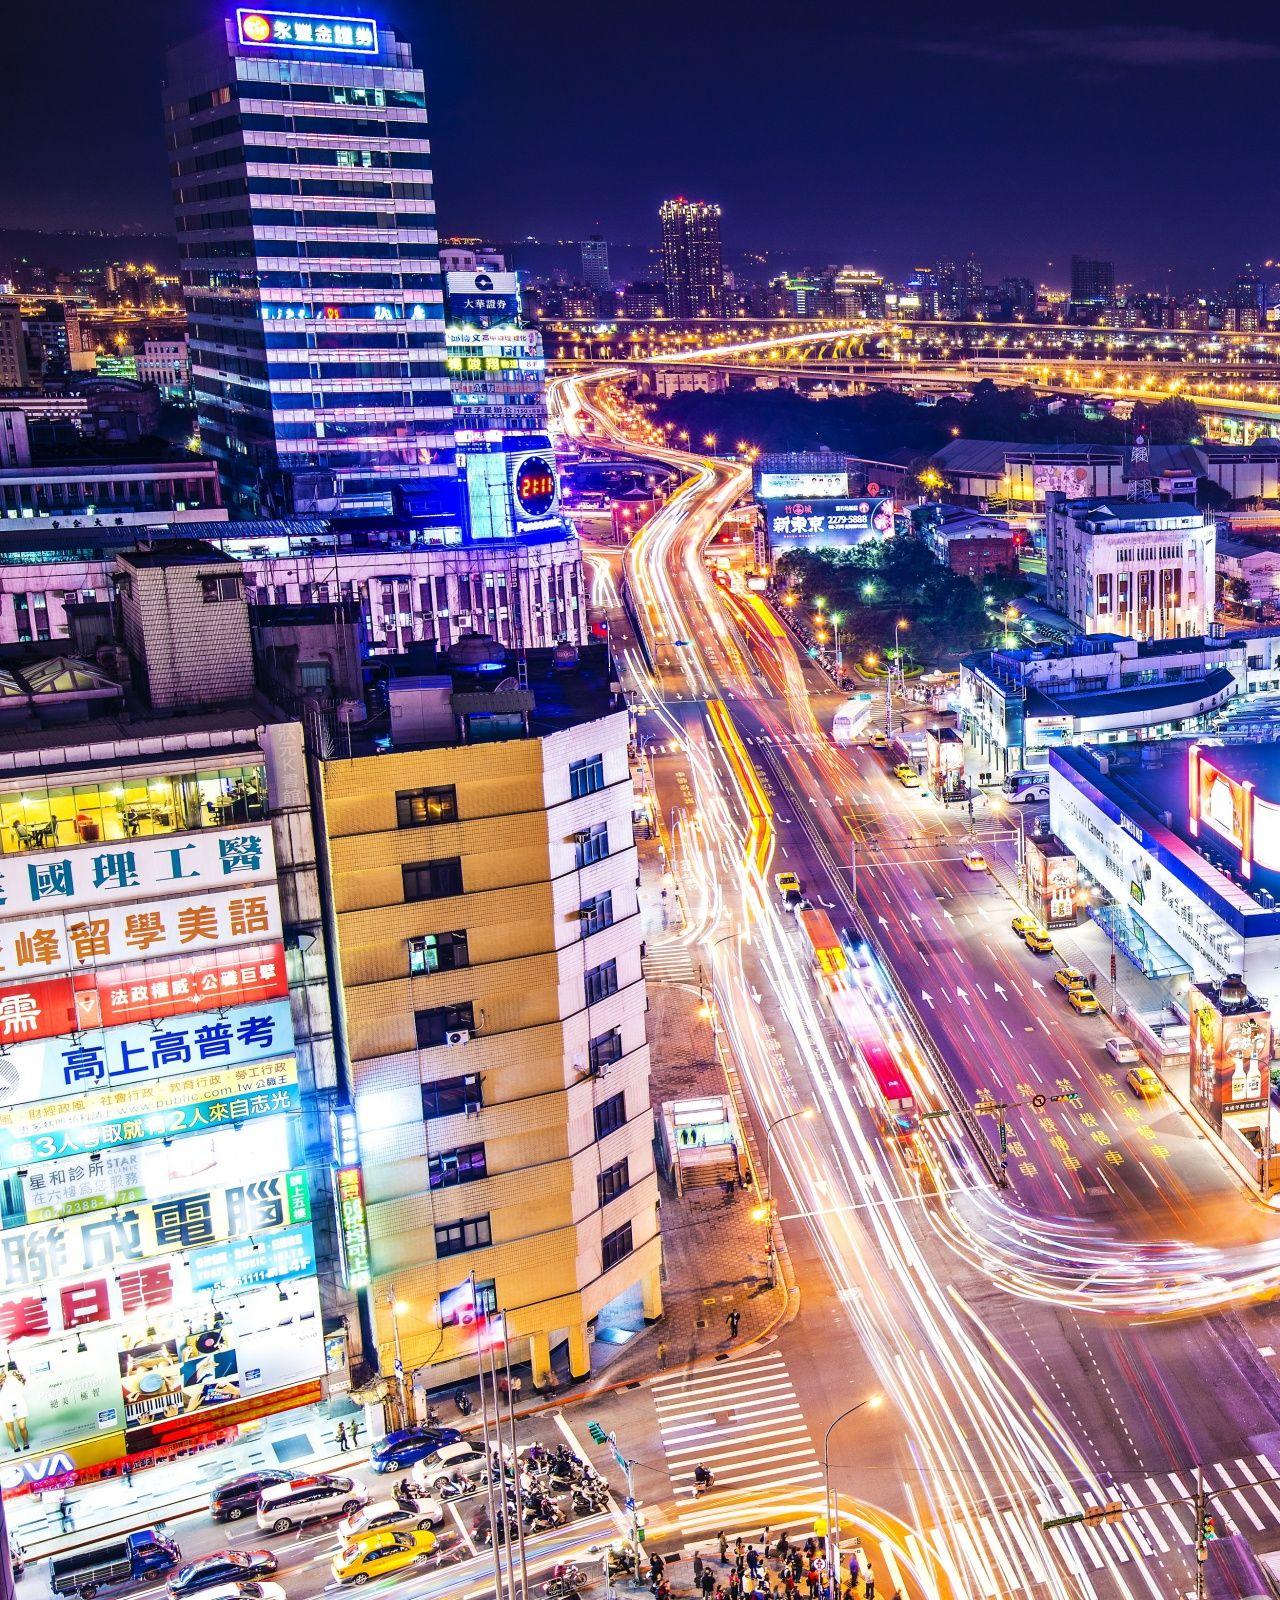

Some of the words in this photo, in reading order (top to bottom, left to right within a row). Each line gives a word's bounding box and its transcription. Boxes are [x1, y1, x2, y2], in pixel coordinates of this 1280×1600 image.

[522, 477, 552, 498] 21:11
[0, 835, 262, 904] 國理工醫
[0, 896, 269, 971] 峰留學美語
[62, 1015, 276, 1085] 高上高普考
[30, 1160, 104, 1191] 星和診所
[106, 1154, 137, 1168] STAR
[1, 1178, 284, 1286] 聯成電腦
